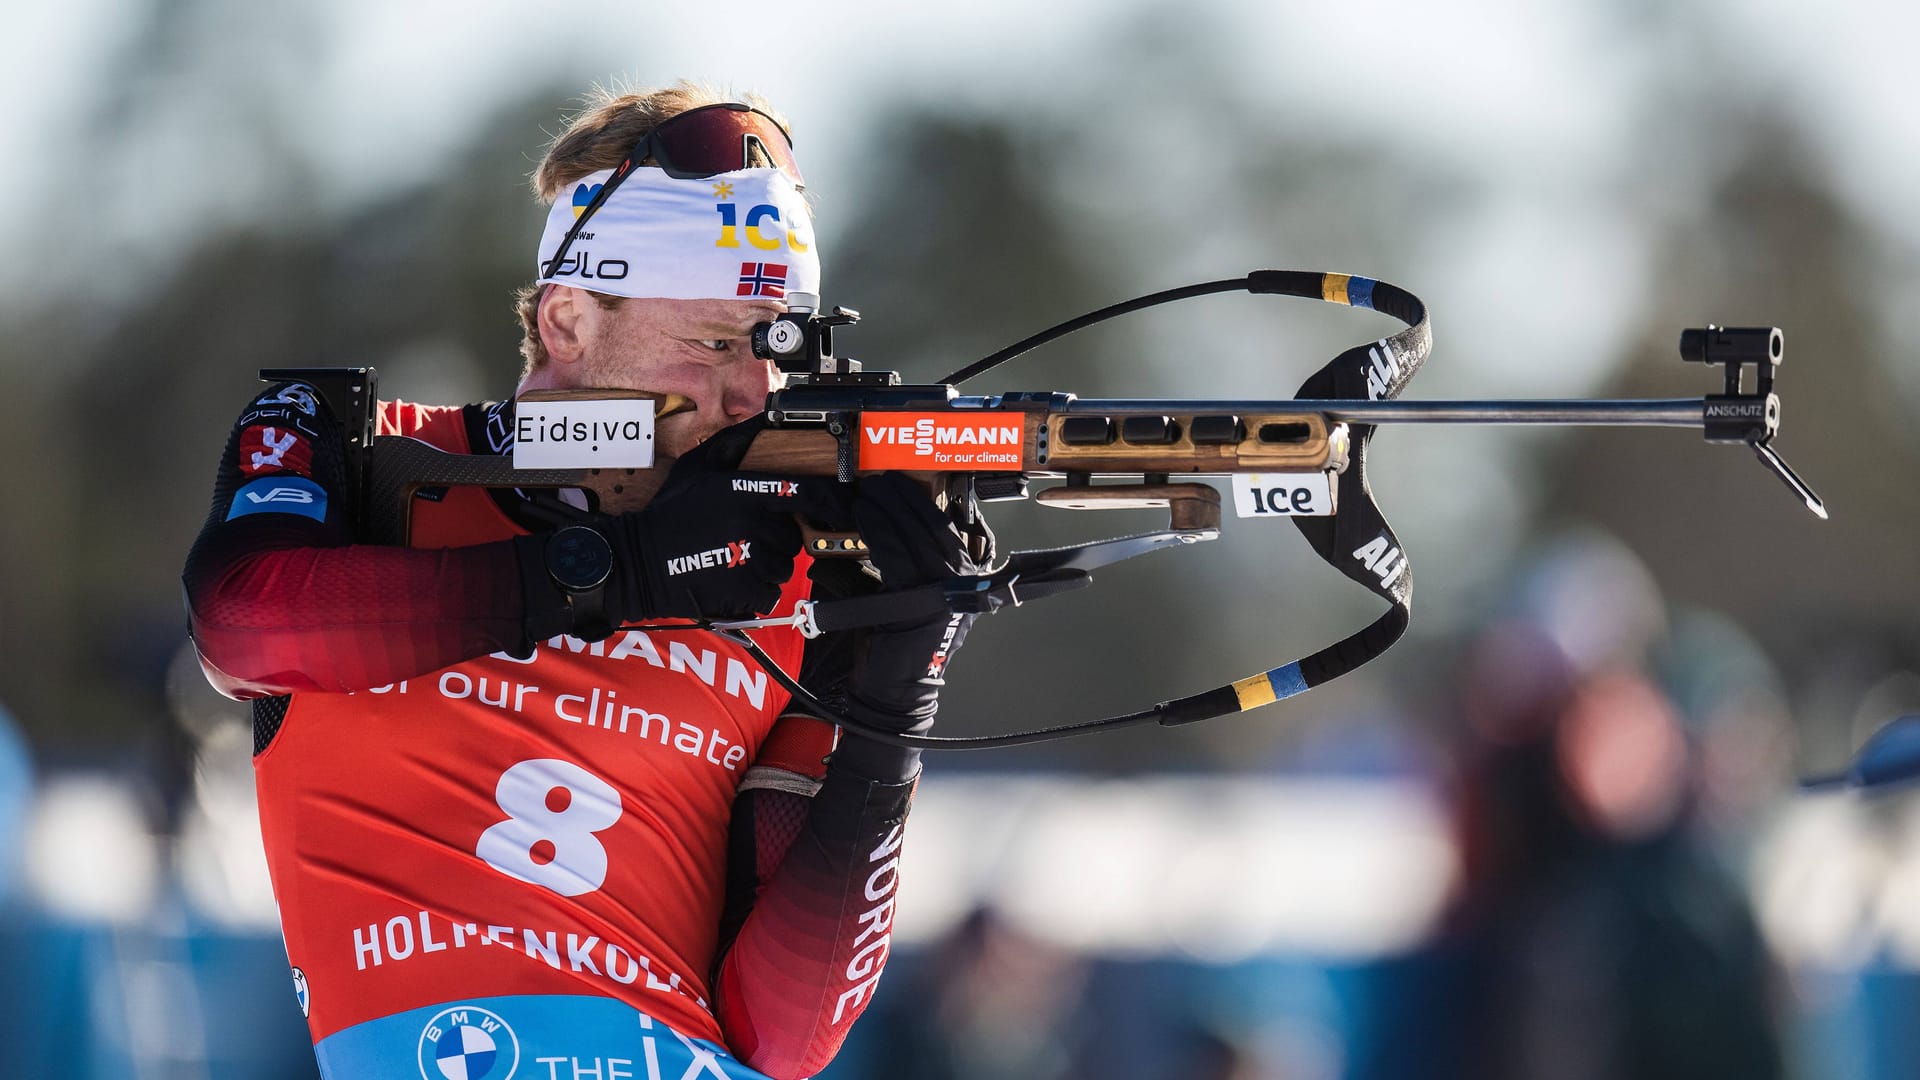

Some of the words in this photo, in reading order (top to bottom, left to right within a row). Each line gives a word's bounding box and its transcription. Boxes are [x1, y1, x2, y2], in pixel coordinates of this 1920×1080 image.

[865, 419, 1019, 456] VIESSMANN
[935, 452, 953, 463] for
[954, 455, 974, 463] our
[976, 452, 1018, 463] climate
[246, 487, 313, 503] VB
[1251, 476, 1315, 514] ice
[439, 672, 538, 713] our
[554, 687, 746, 771] climate
[476, 759, 623, 897] 8
[427, 1011, 500, 1043] BMW
